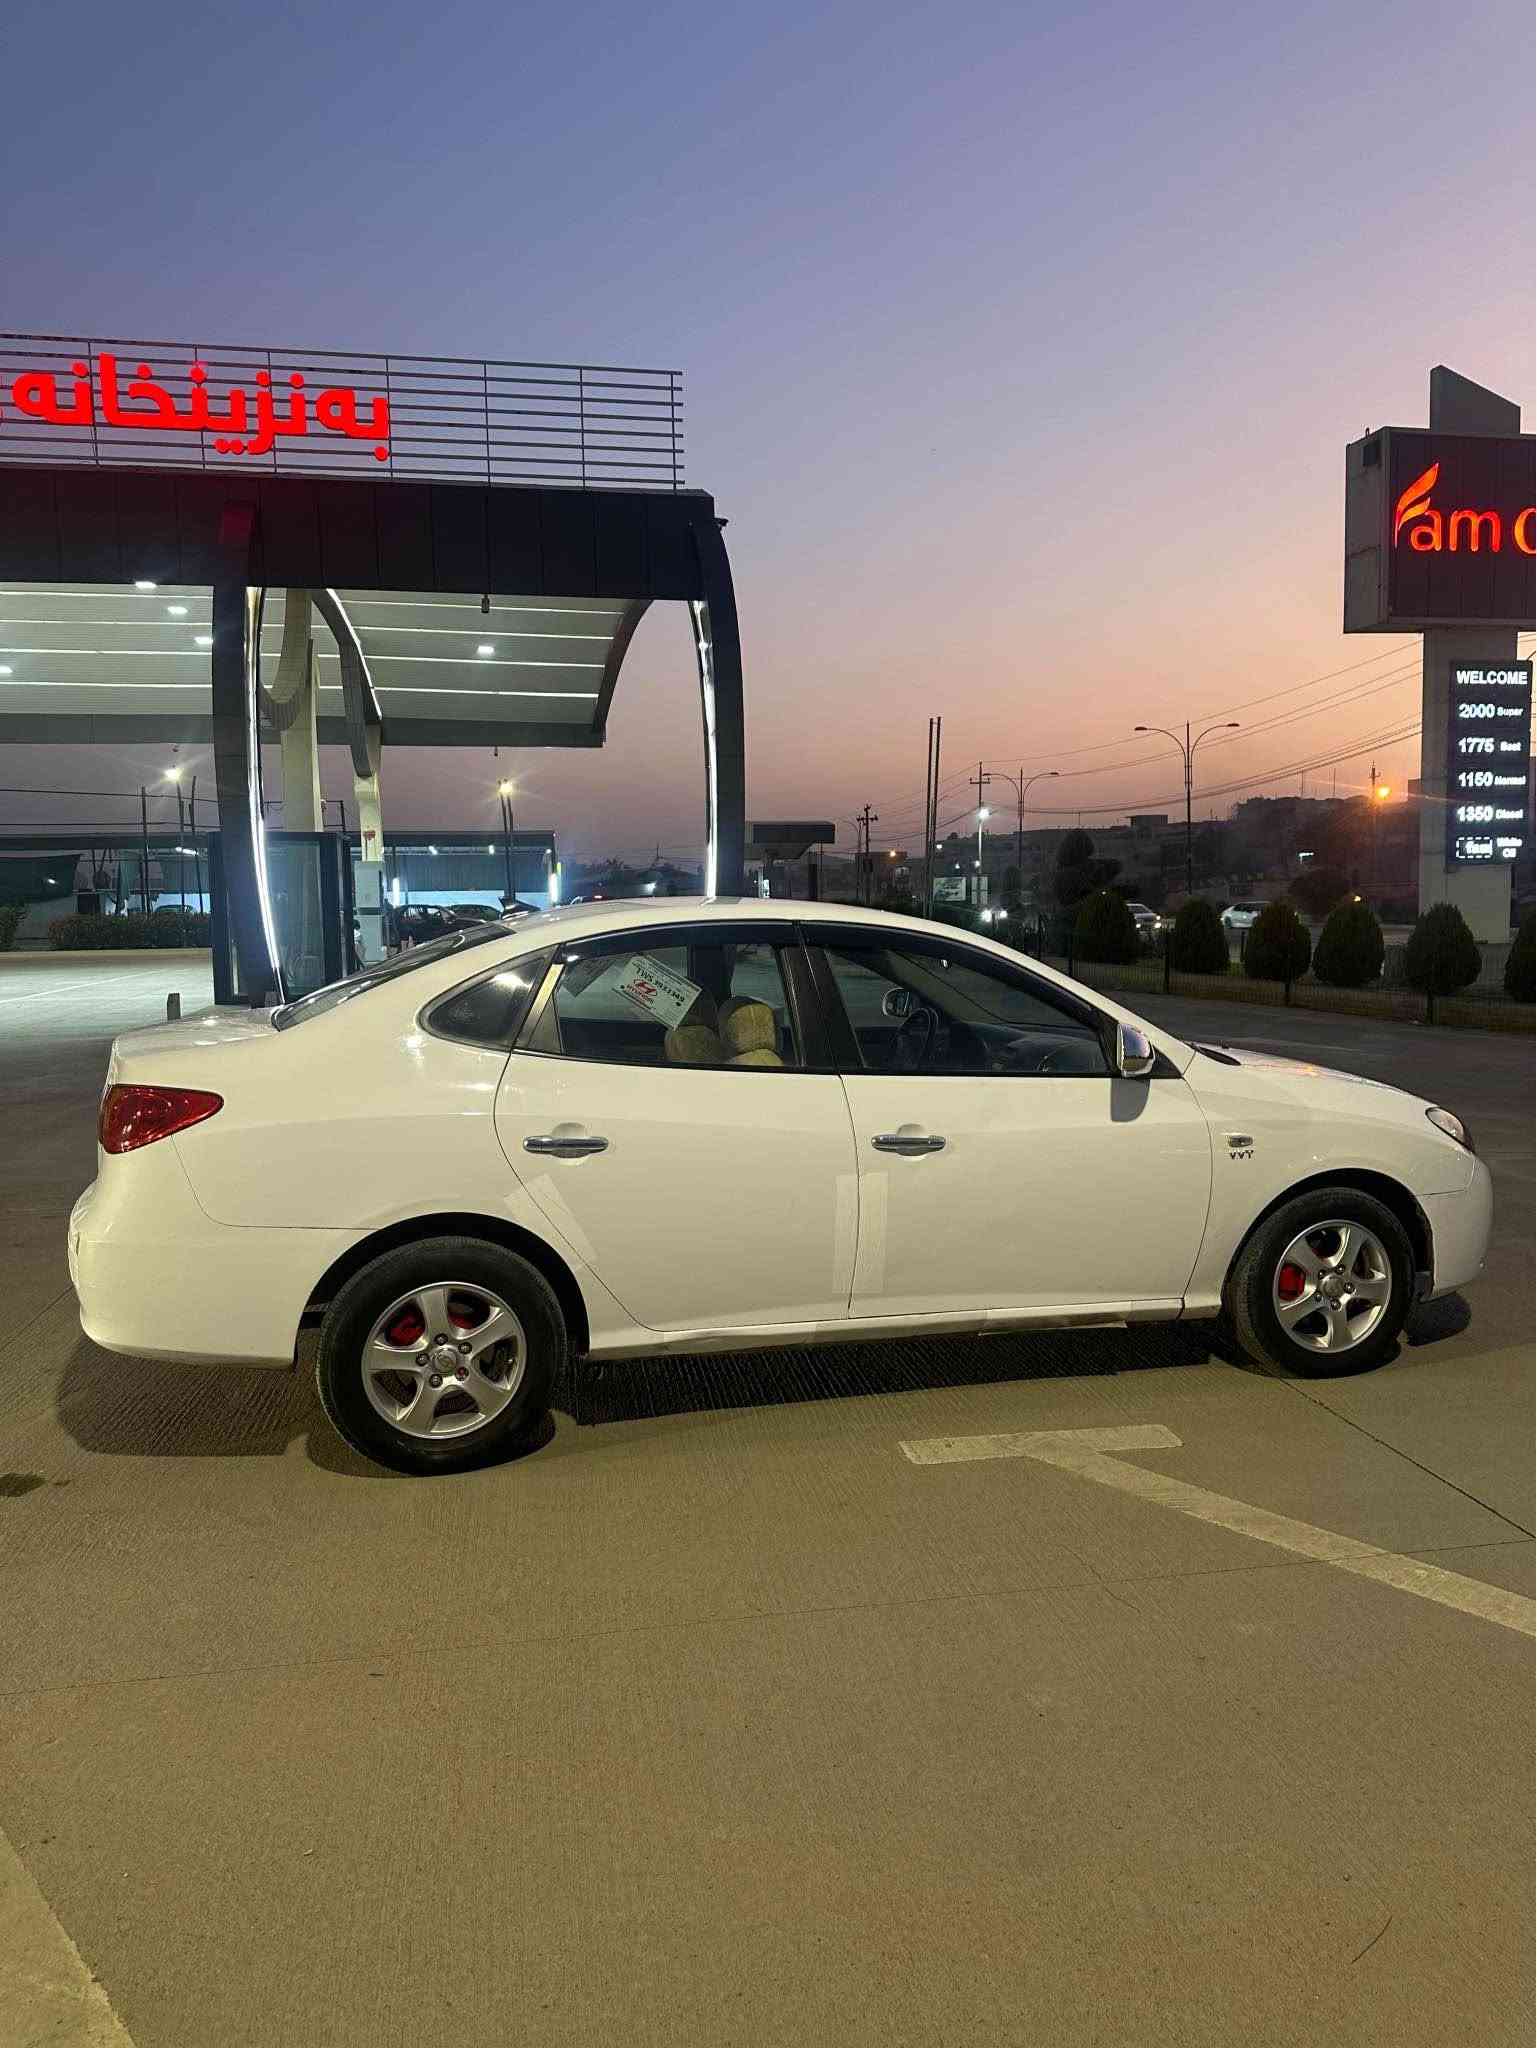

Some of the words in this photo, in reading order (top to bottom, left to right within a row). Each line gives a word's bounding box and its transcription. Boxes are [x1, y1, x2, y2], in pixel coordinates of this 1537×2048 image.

[1456, 670, 1528, 685] WELCOME
[1458, 703, 1495, 718] 2000
[1458, 737, 1494, 753] 1775
[1458, 771, 1493, 788] 1150
[1456, 805, 1494, 823] 1350
[1229, 1149, 1254, 1160] VVT
